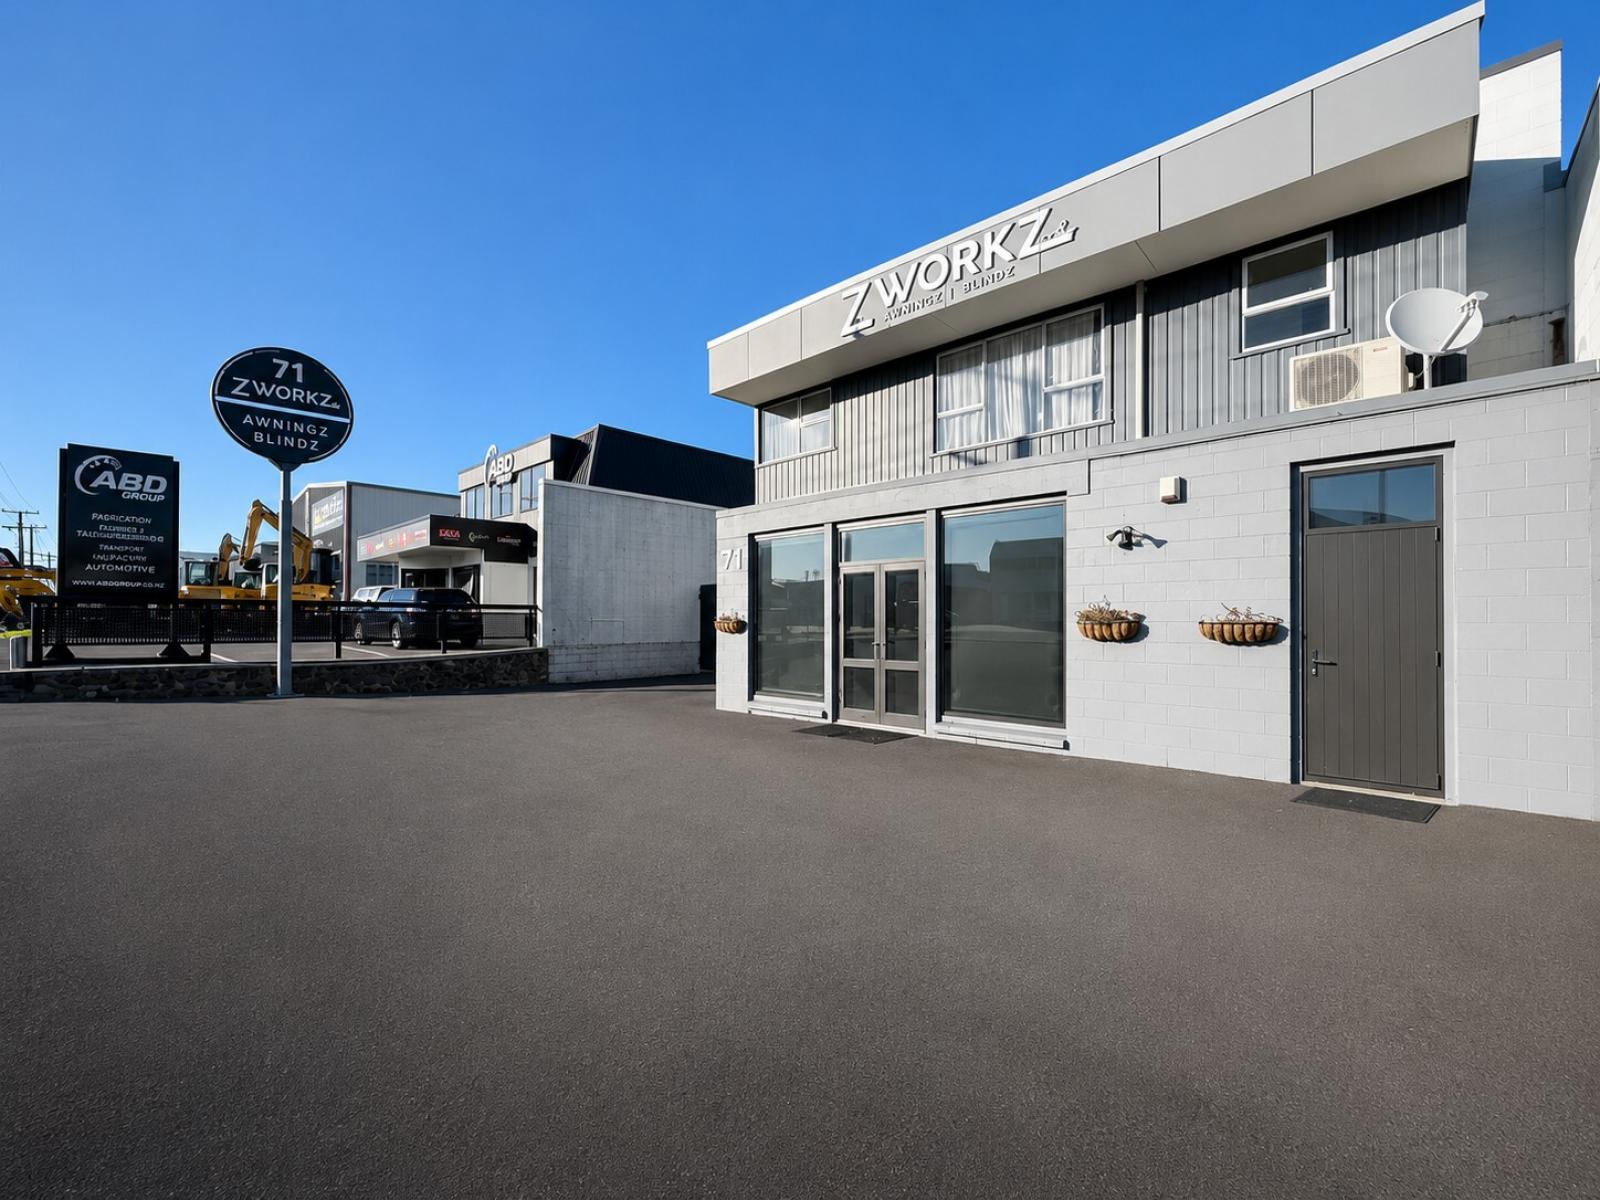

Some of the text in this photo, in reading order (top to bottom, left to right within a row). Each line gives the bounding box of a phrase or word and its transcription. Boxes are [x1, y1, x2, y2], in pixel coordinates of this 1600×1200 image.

[884, 266, 1015, 322] AWNINGZ BLINDZ
[272, 358, 304, 383] 71
[242, 414, 329, 438] AWNINGZ
[254, 431, 320, 452] BLINDZ
[89, 470, 168, 494] ABD
[121, 491, 166, 502] GROUP
[85, 563, 156, 574] AUTOMOTIVE
[720, 549, 743, 570] 71
